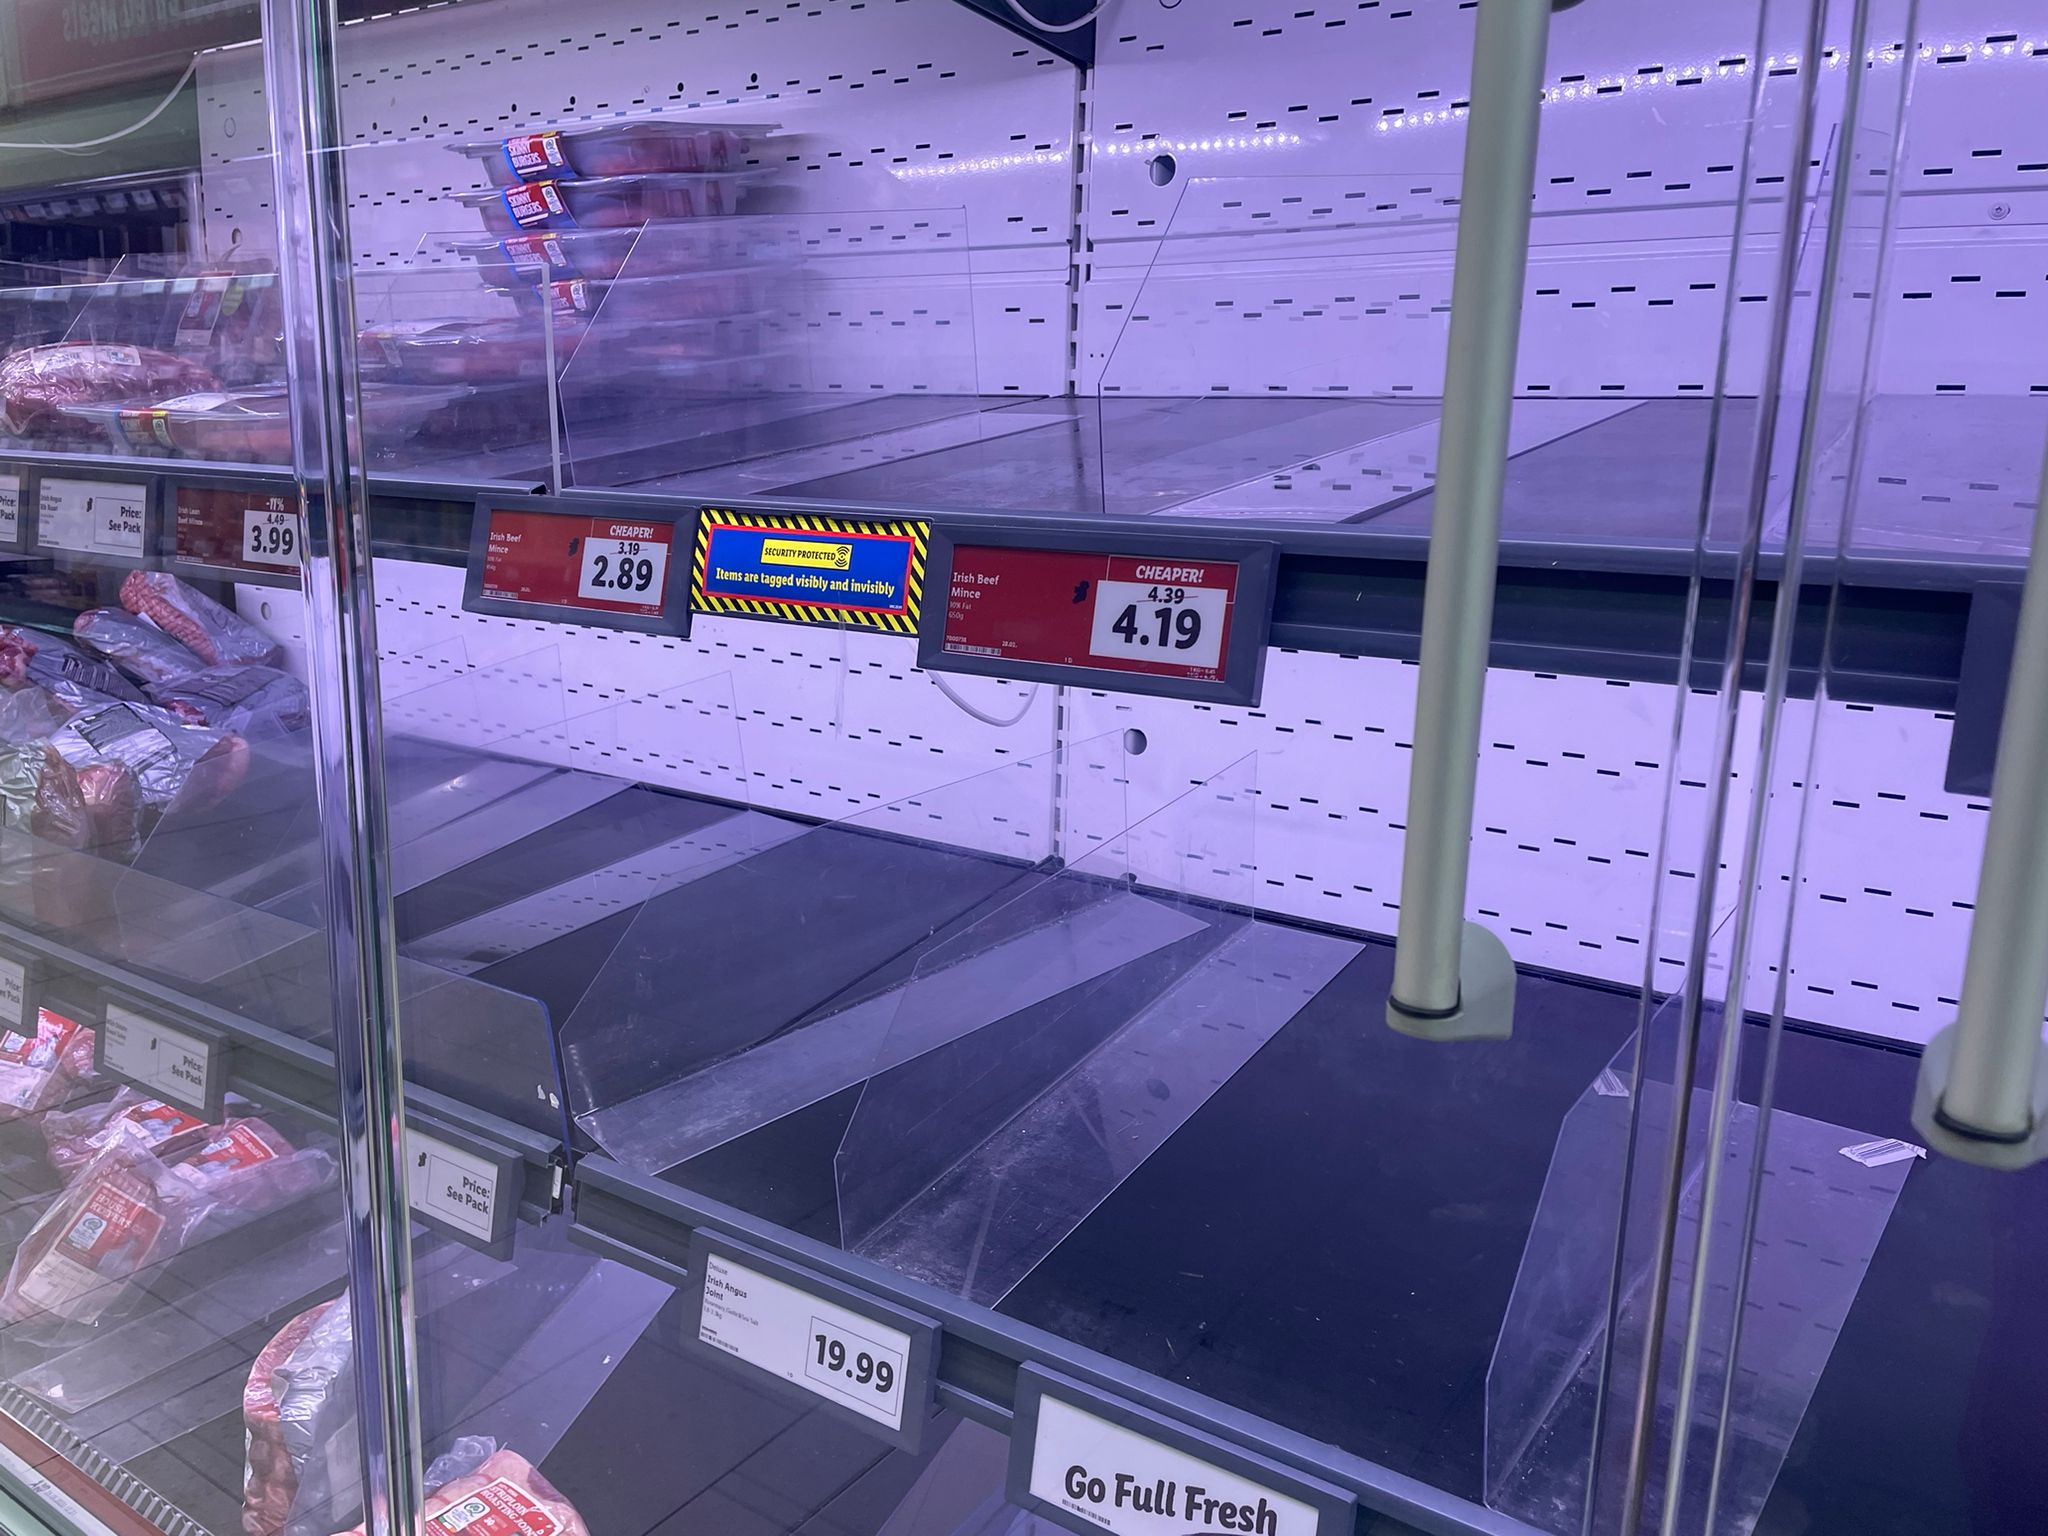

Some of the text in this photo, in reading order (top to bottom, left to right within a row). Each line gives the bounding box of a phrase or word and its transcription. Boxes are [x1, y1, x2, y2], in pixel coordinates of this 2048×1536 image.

[120, 507, 141, 519] Price:
[267, 514, 285, 526] 4.49
[109, 520, 141, 533] See Pack
[610, 525, 654, 539] CHEAPER!
[252, 525, 294, 555] 3.99
[490, 532, 522, 543] Irish Beef
[488, 544, 509, 554] Mince
[617, 542, 640, 555] 3.19
[764, 547, 836, 561] SECURITY PROTECTED
[591, 555, 653, 592] 2.89
[716, 567, 895, 598] Items are tagged visibly and invisibly
[953, 573, 1001, 586] Irish Beef
[1136, 565, 1205, 584] CHEAPER!
[951, 587, 981, 599] Mince
[1147, 586, 1184, 605] 4.39
[1112, 603, 1202, 650] 4.19
[183, 1055, 204, 1074] Price:
[171, 1064, 203, 1087] See Pack
[462, 1175, 491, 1199] Price:
[447, 1185, 489, 1214] See Pack
[705, 1286, 724, 1302] Joint
[707, 1274, 748, 1300] Irish Angus
[814, 1333, 894, 1393] 19.99
[479, 1489, 518, 1520] ROASTING
[489, 1485, 529, 1516] STRIPLOIN
[1064, 1465, 1278, 1536] Go Full Fresh
